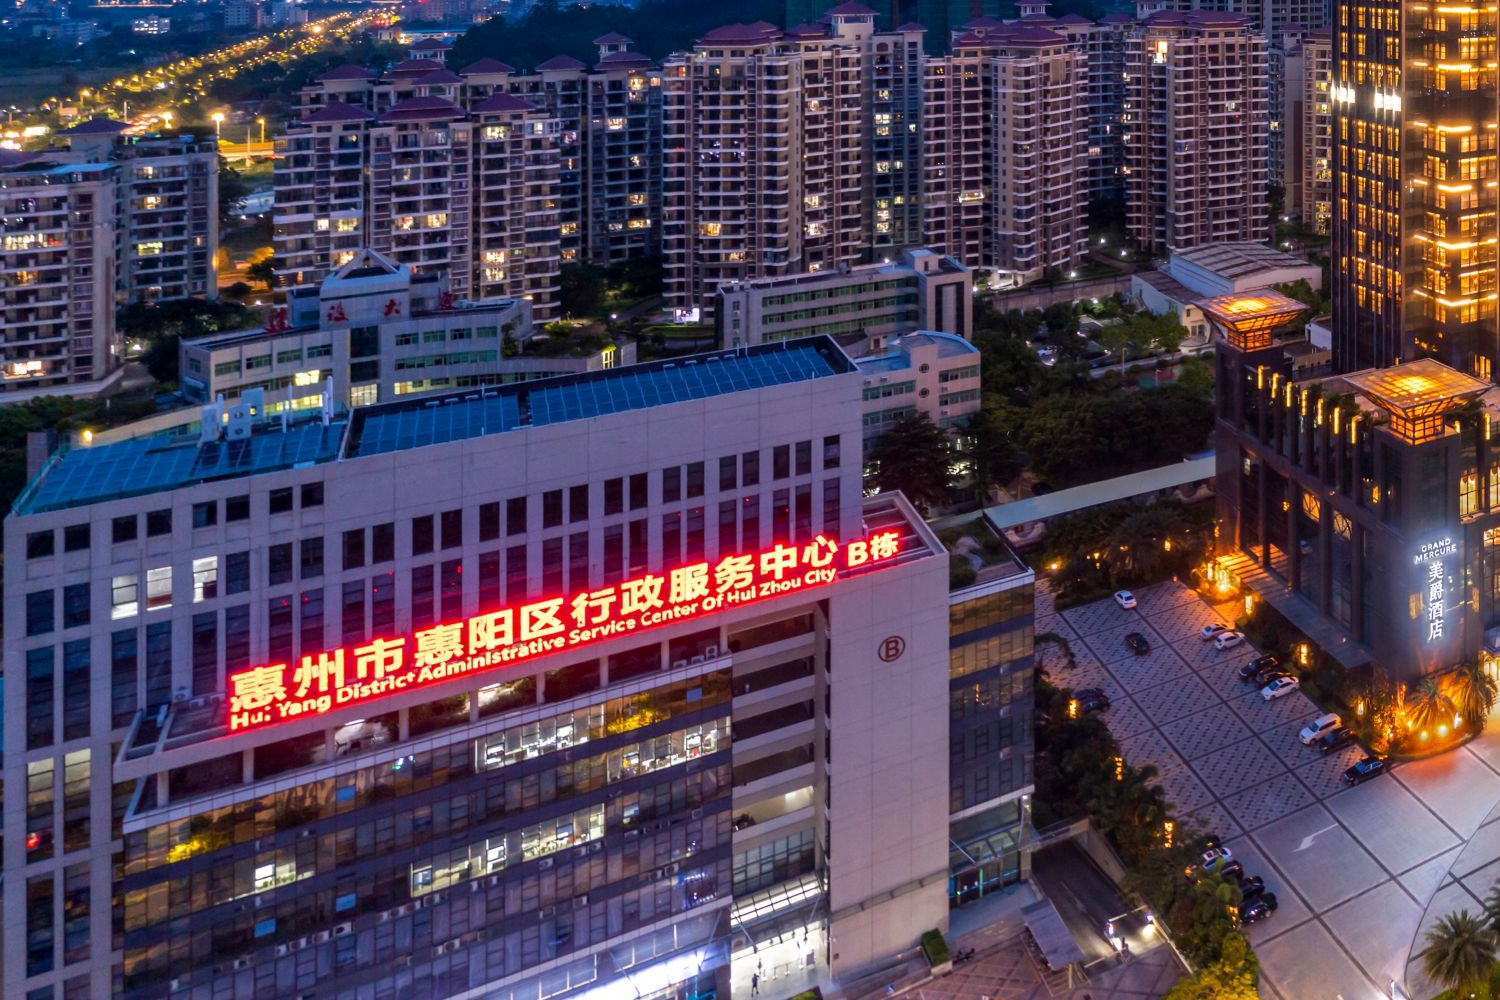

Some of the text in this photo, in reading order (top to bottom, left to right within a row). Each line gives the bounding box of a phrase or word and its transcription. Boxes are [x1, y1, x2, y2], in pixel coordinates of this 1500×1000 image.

[1414, 544, 1457, 564] MERCURE
[1421, 537, 1451, 553] GRAND
[230, 532, 899, 713] 惠州市惠阳区行政服务中心 B栋
[1427, 561, 1444, 643] 美爵酒店
[230, 567, 836, 730] Hui Yang District Administrative Service Center Of Hui Zhou City
